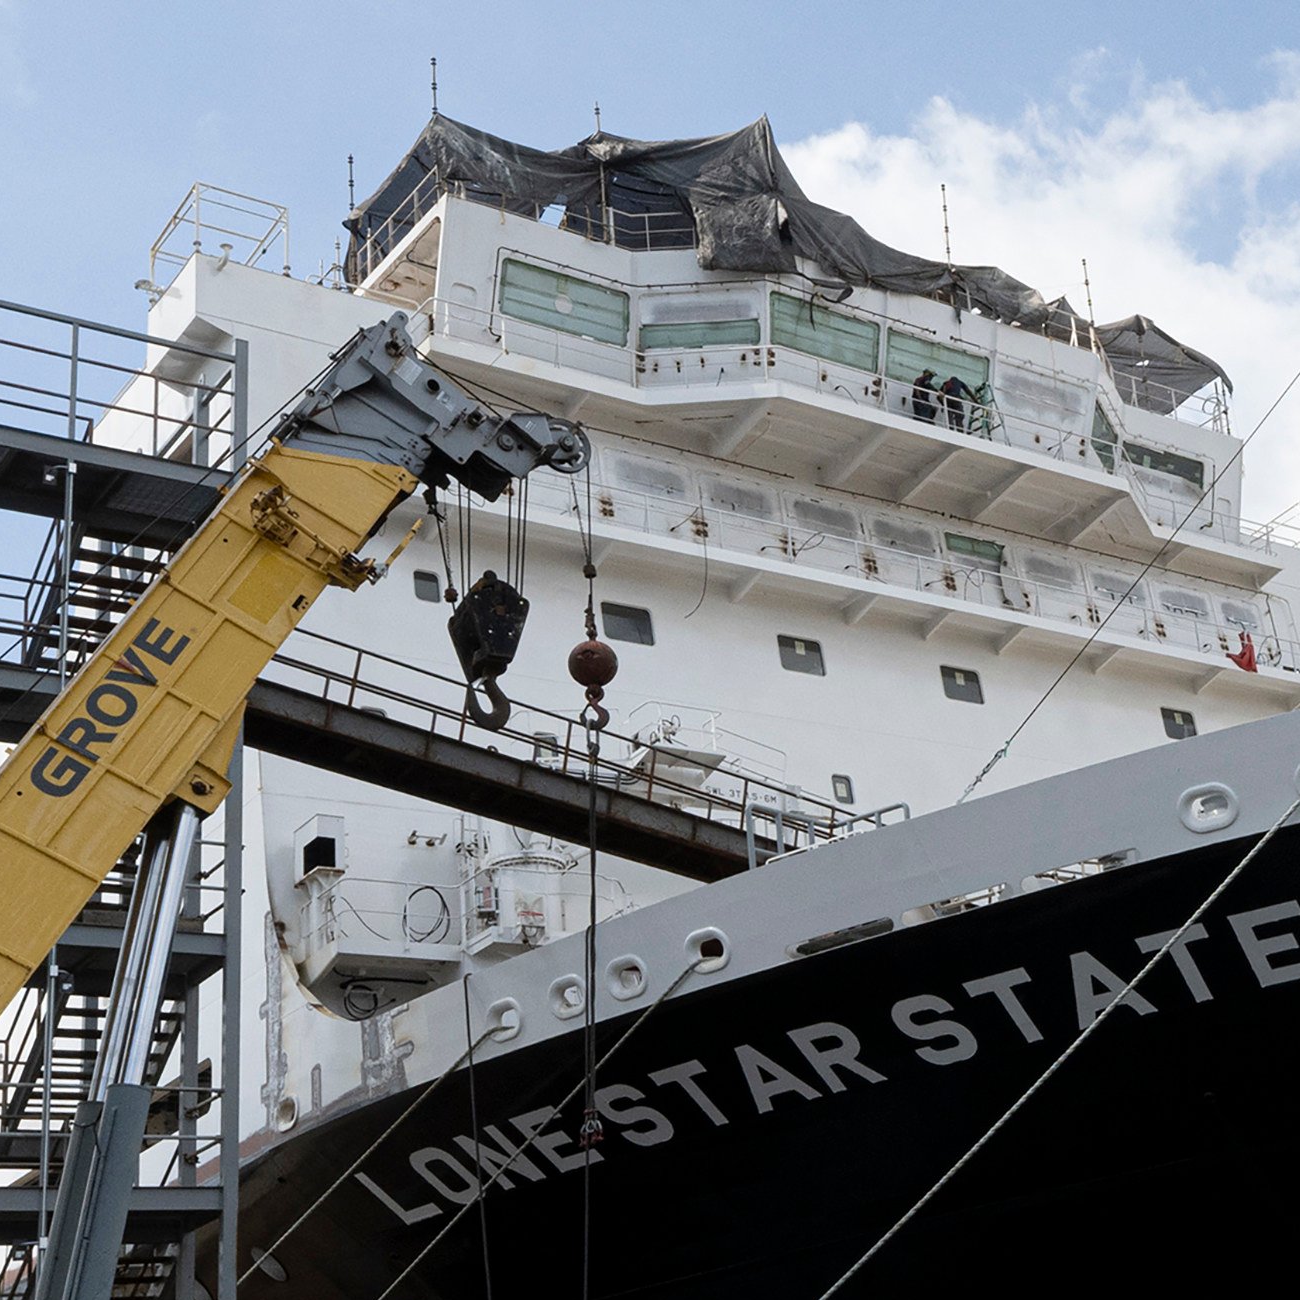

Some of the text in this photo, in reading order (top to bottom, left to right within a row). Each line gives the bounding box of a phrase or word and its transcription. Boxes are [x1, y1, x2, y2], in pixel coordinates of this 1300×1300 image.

[30, 616, 191, 798] GROVE
[354, 1105, 605, 1225] LONE
[593, 1021, 888, 1147] STAR
